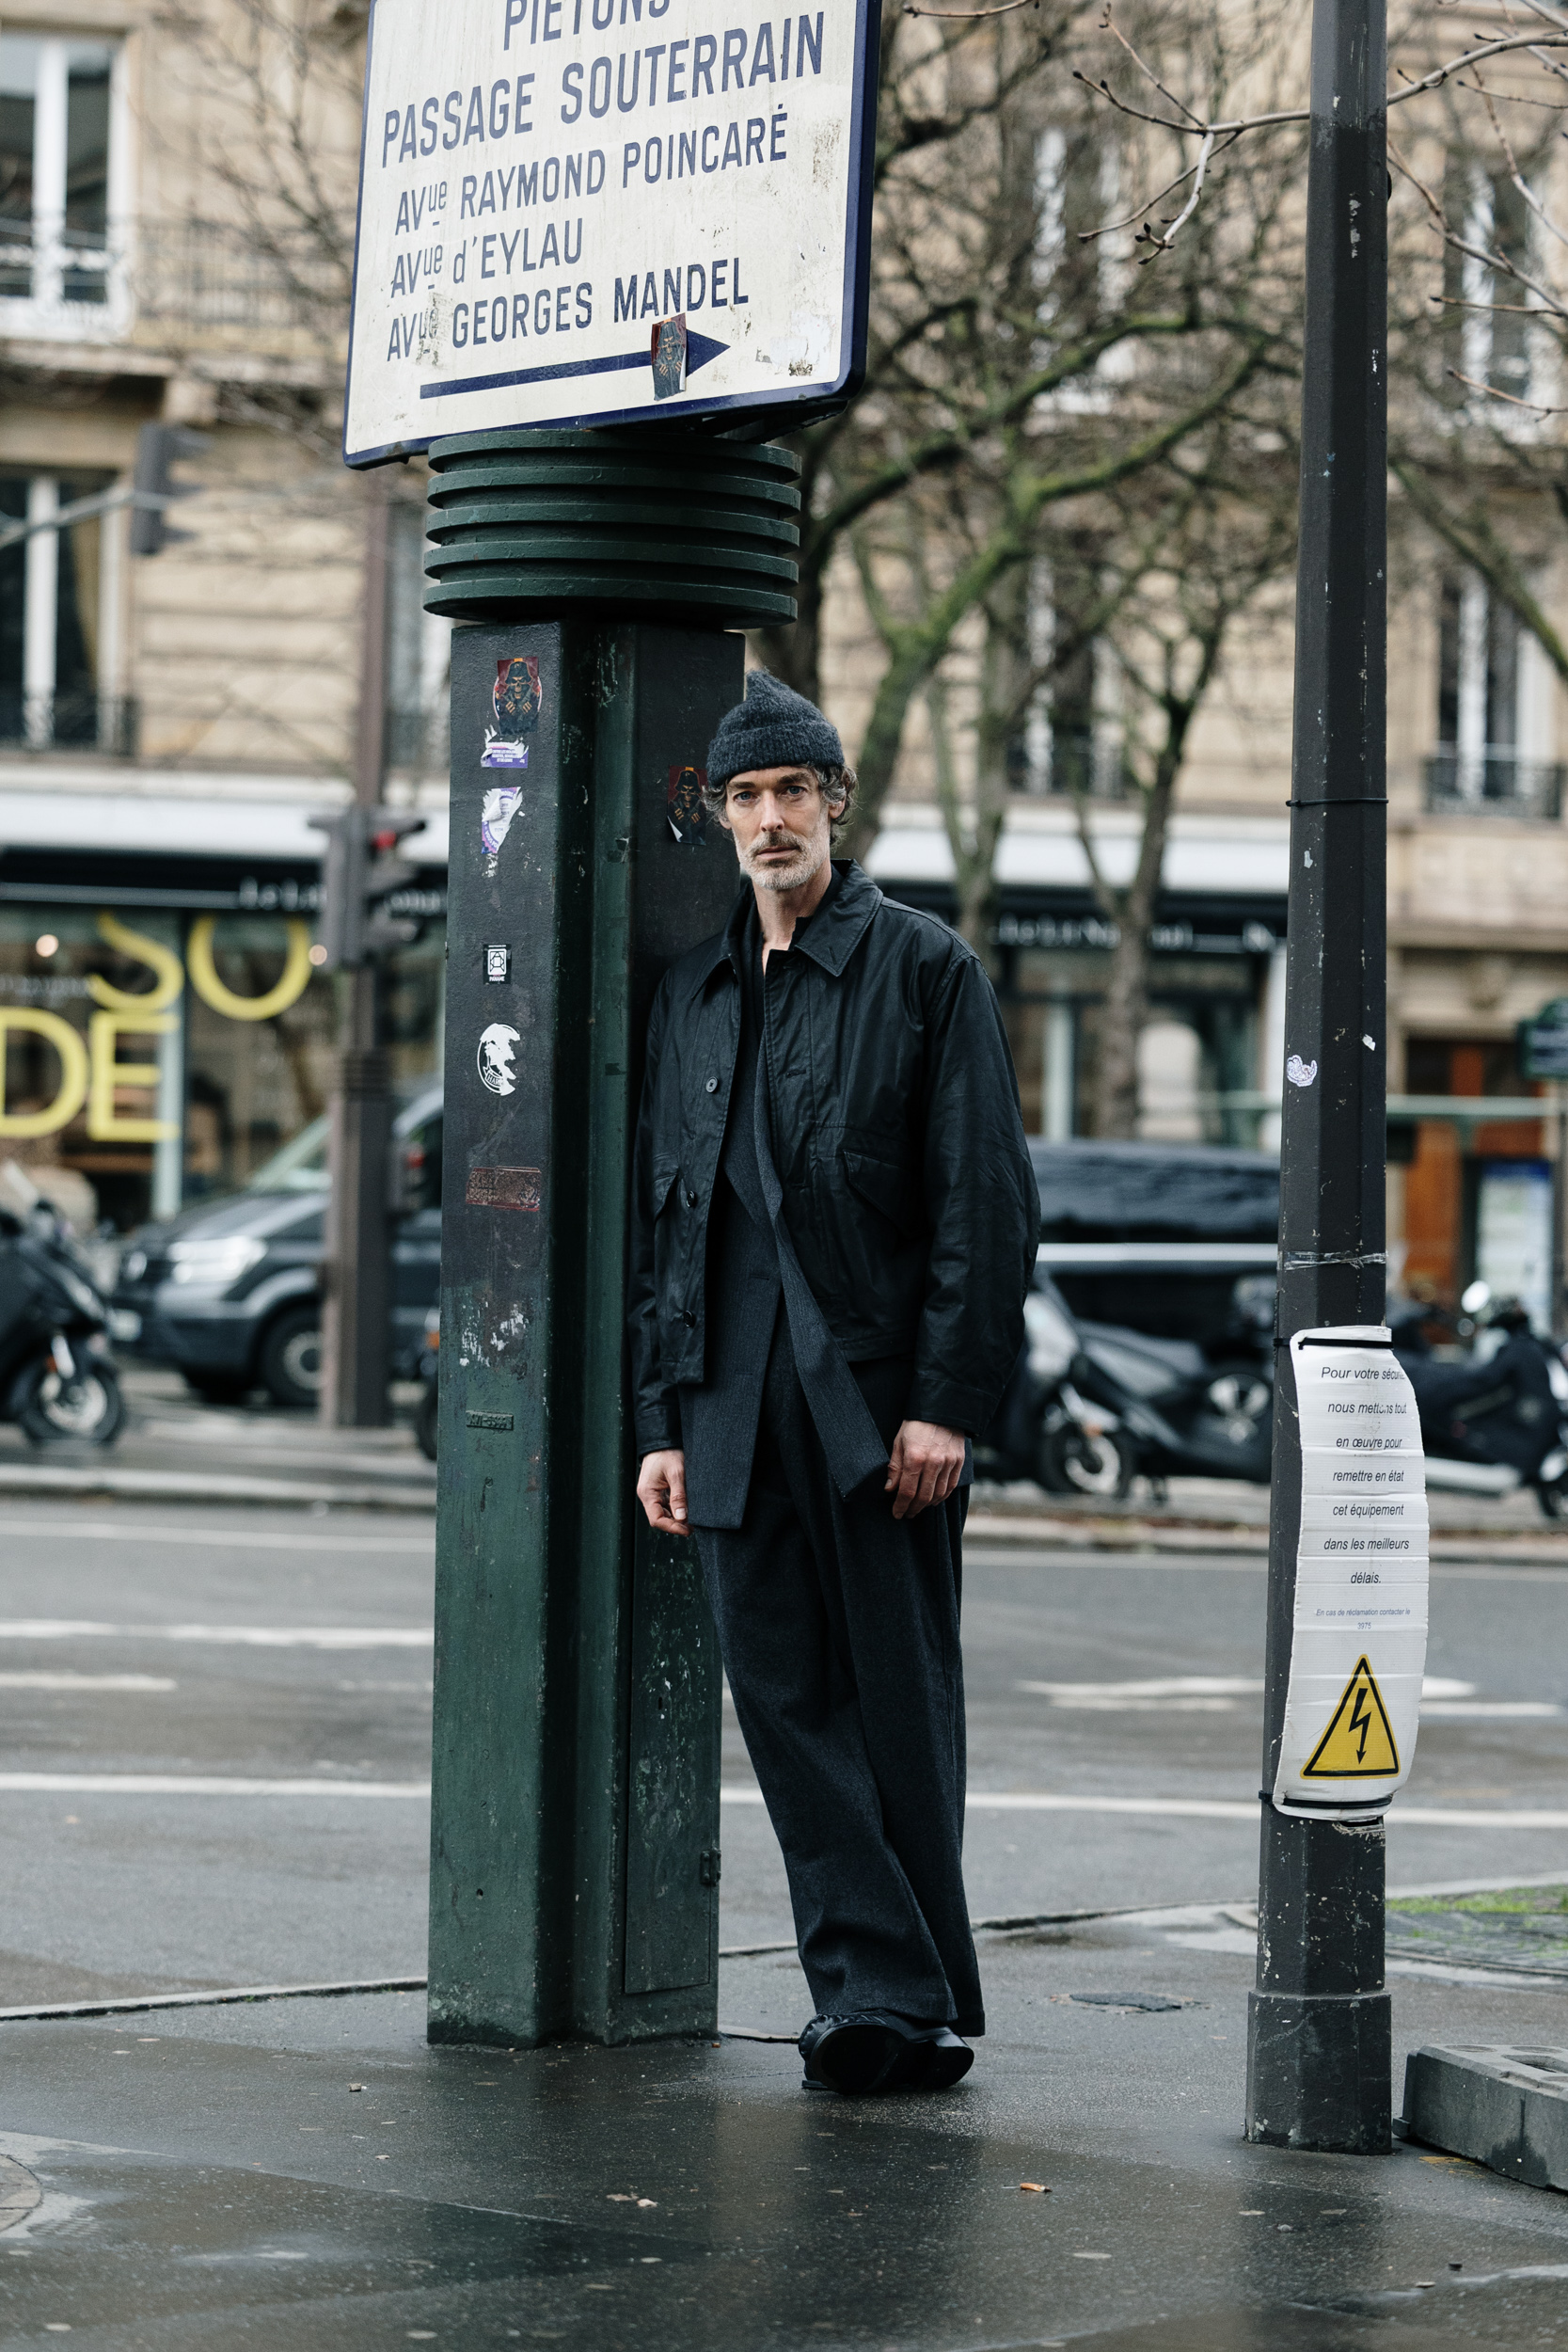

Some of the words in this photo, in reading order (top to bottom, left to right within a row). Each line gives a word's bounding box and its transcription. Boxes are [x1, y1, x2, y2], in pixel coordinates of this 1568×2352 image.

[382, 72, 535, 168] PASSAGE
[561, 11, 825, 124] SOUTERRAIN
[460, 149, 606, 220] RAYMOND
[623, 103, 788, 189] POINCARÉ
[452, 217, 583, 284] d'EYLAU
[452, 282, 594, 349] GEORGES
[613, 257, 749, 324] MANDEL
[1321, 1366, 1352, 1379] Pour
[1354, 1368, 1379, 1380] votre
[1327, 1403, 1355, 1413] nous
[1394, 1402, 1407, 1414] tout
[1336, 1438, 1349, 1448] en
[1352, 1438, 1383, 1449] œuvre
[1384, 1438, 1402, 1450] pour
[1332, 1470, 1373, 1482] remettre
[1374, 1471, 1386, 1482] en
[1387, 1470, 1404, 1482] état
[1332, 1503, 1348, 1516] cet
[1350, 1503, 1404, 1518] équipement
[1323, 1537, 1349, 1550] dans
[1350, 1537, 1366, 1550] les
[1367, 1537, 1410, 1549] meilleurs
[1350, 1571, 1382, 1584] délais.
[1315, 1608, 1324, 1616] En
[1346, 1608, 1378, 1616] réclamation
